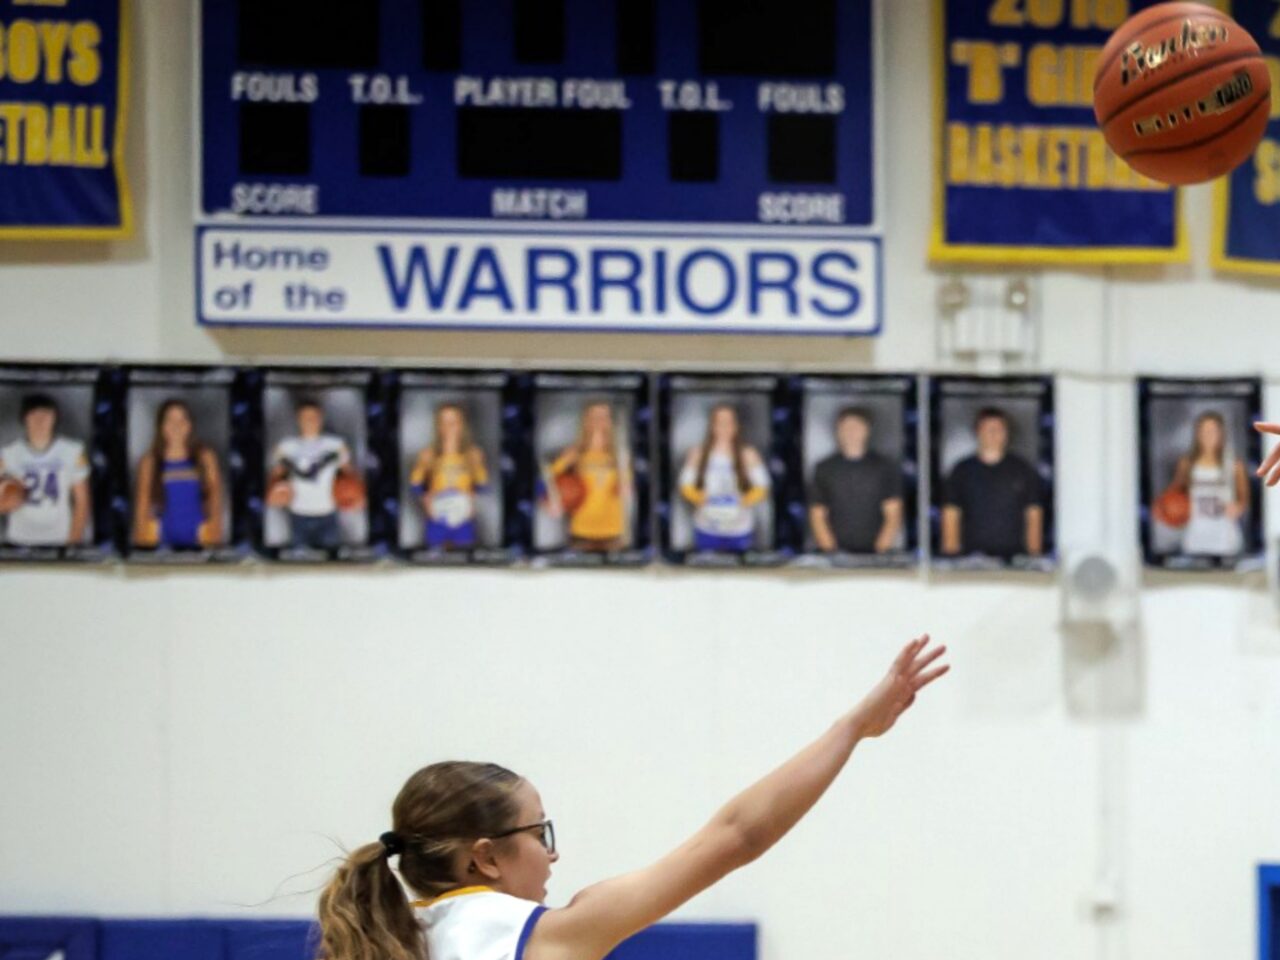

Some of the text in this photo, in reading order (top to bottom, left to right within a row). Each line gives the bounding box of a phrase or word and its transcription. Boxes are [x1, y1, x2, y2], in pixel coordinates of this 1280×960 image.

[0, 19, 102, 86] OYS
[231, 72, 318, 102] FOULS
[349, 74, 422, 104] T.O.L.
[454, 76, 632, 110] PLAYER FOUL
[757, 82, 845, 114] FOULS
[230, 184, 319, 214] SCORE
[491, 188, 588, 219] MATCH
[757, 192, 845, 223] SCORE
[213, 242, 329, 271] Home
[213, 282, 347, 311] of the
[376, 244, 861, 318] WARRIORS
